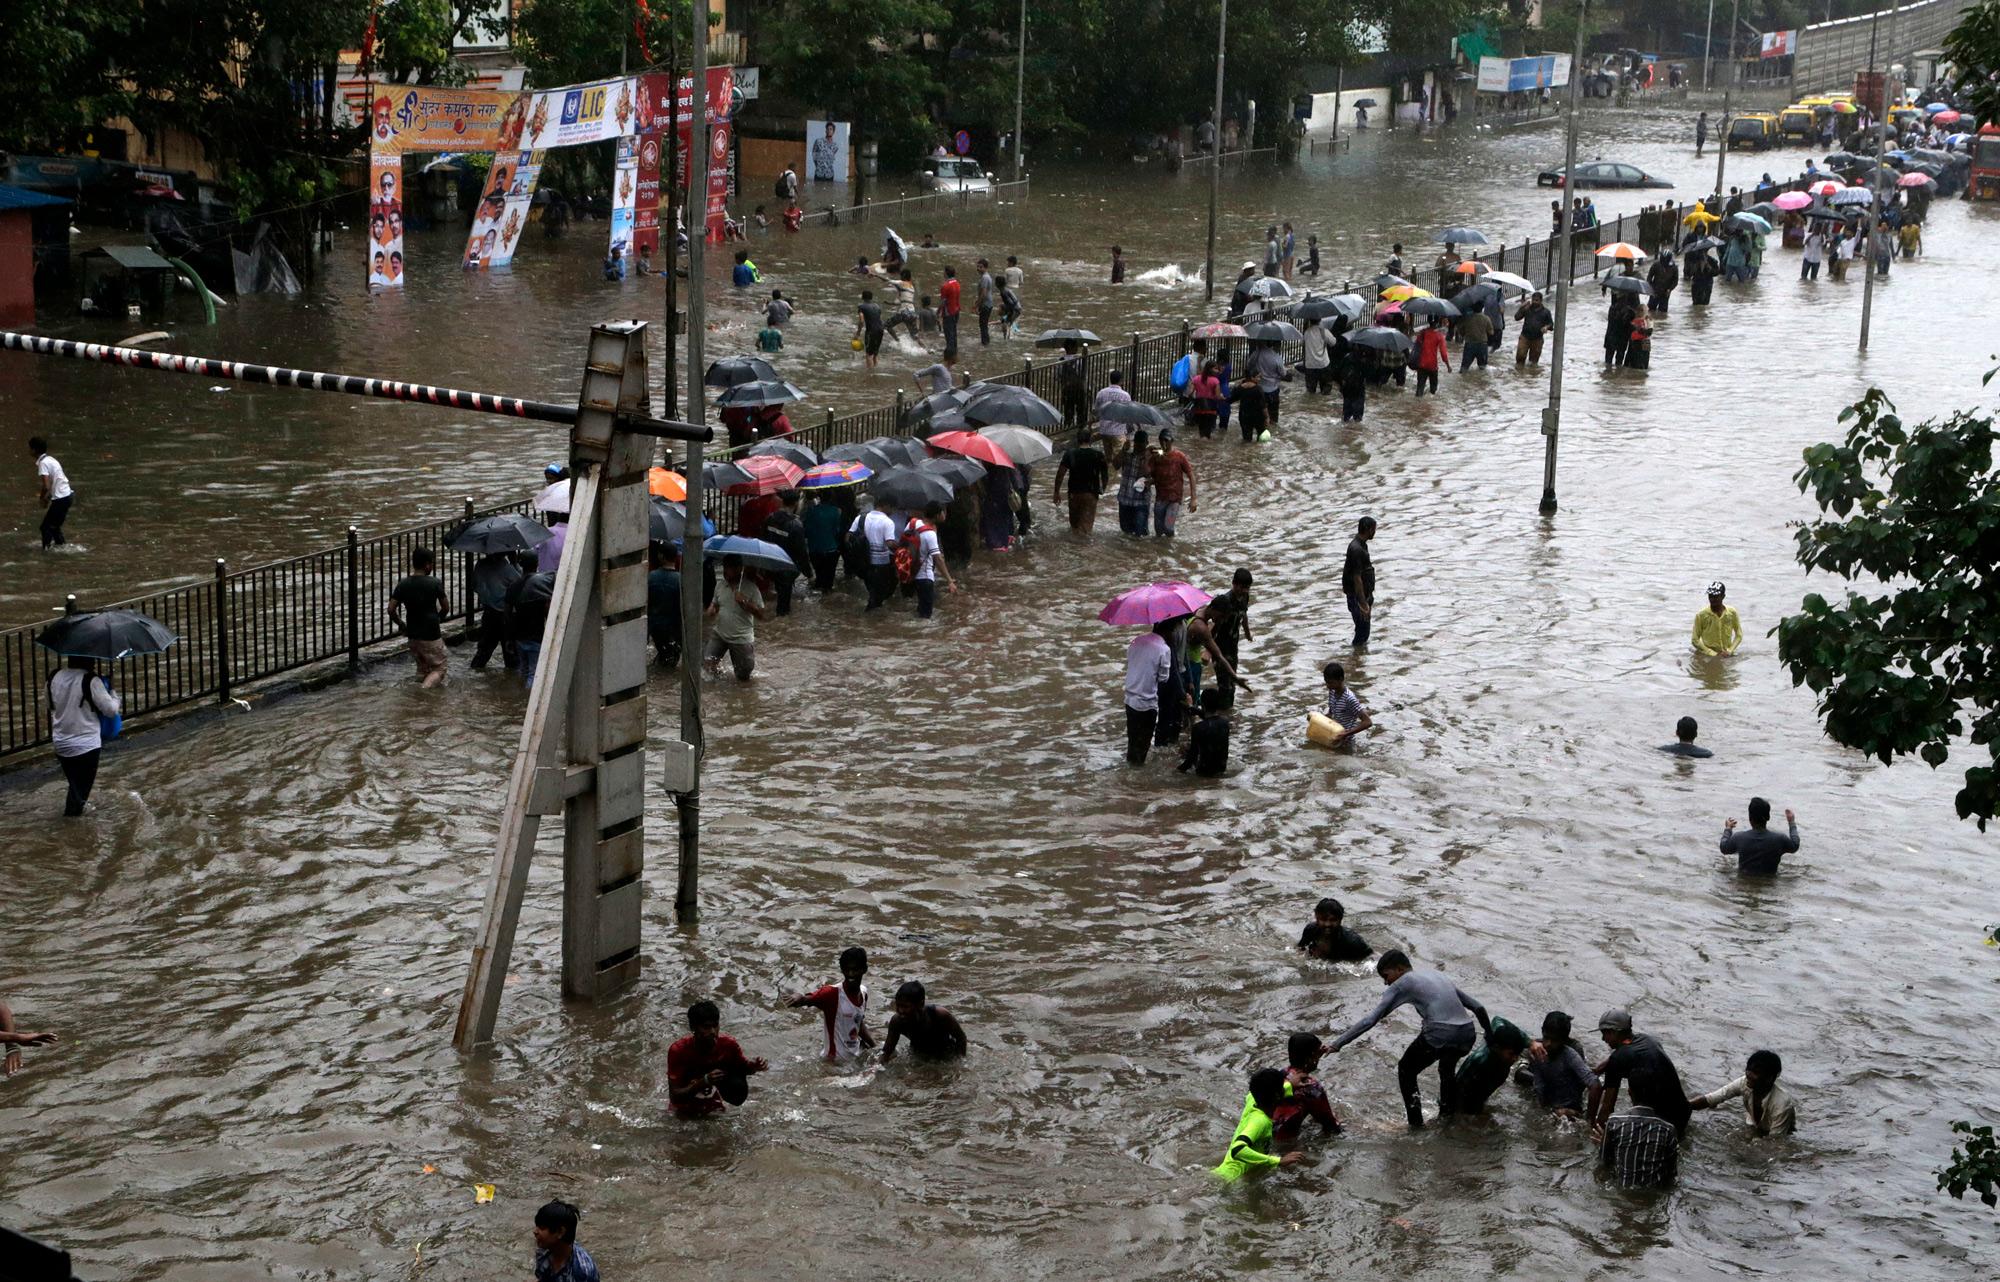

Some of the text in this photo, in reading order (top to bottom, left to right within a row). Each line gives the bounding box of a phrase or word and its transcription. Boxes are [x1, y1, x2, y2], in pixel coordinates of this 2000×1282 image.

[393, 91, 418, 133] श्री
[581, 90, 604, 118] LIC
[530, 151, 545, 165] LIC
